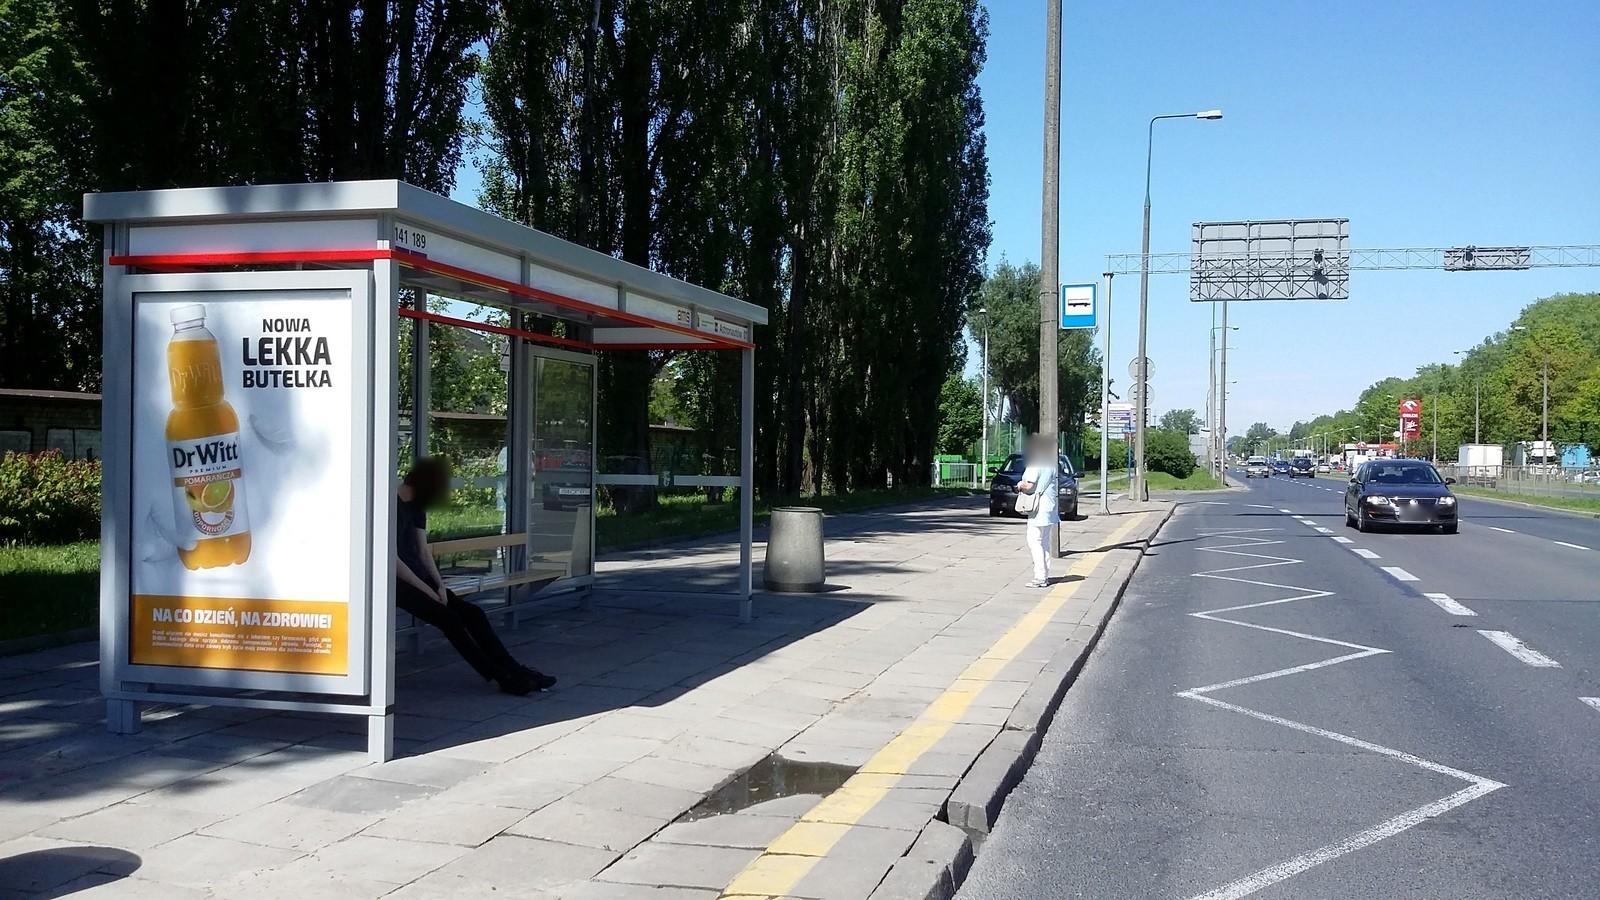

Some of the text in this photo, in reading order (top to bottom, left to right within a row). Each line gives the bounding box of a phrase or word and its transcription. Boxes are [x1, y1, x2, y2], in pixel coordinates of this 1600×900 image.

[395, 227, 426, 249] 141 189
[262, 318, 311, 333] NOWA
[242, 336, 332, 366] LEKKA
[242, 369, 333, 389] BUTELKA
[152, 606, 332, 629] NA CO DZIEŃ, NA ZDROWIE!
